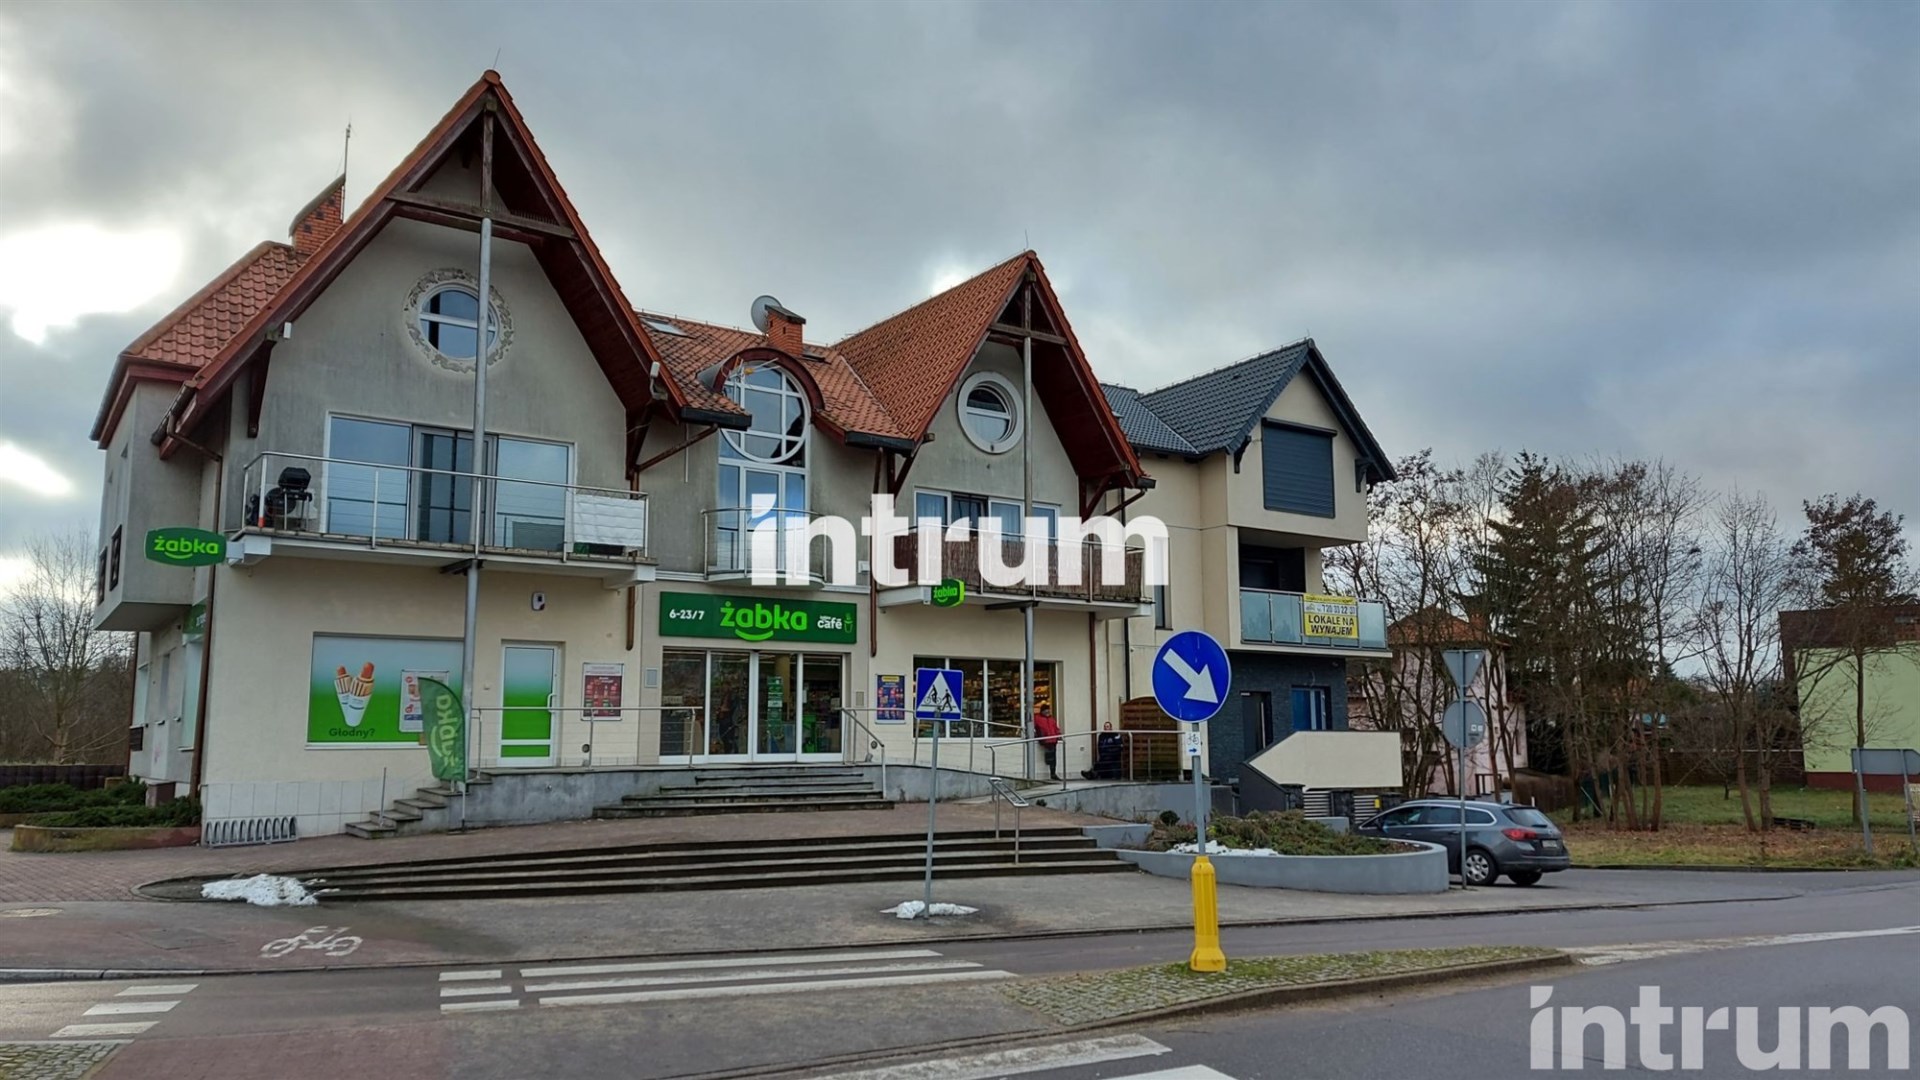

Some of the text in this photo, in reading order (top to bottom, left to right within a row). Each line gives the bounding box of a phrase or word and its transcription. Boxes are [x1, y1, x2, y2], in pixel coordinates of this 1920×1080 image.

[153, 535, 219, 555] żabka
[933, 586, 958, 599] żabka
[669, 609, 705, 620] 6-23/7
[720, 601, 808, 631] żabka
[1308, 615, 1354, 626] LOKALE NA
[817, 617, 842, 629] café
[1311, 625, 1352, 635] WYNAJEM
[328, 727, 375, 739] Głodny?
